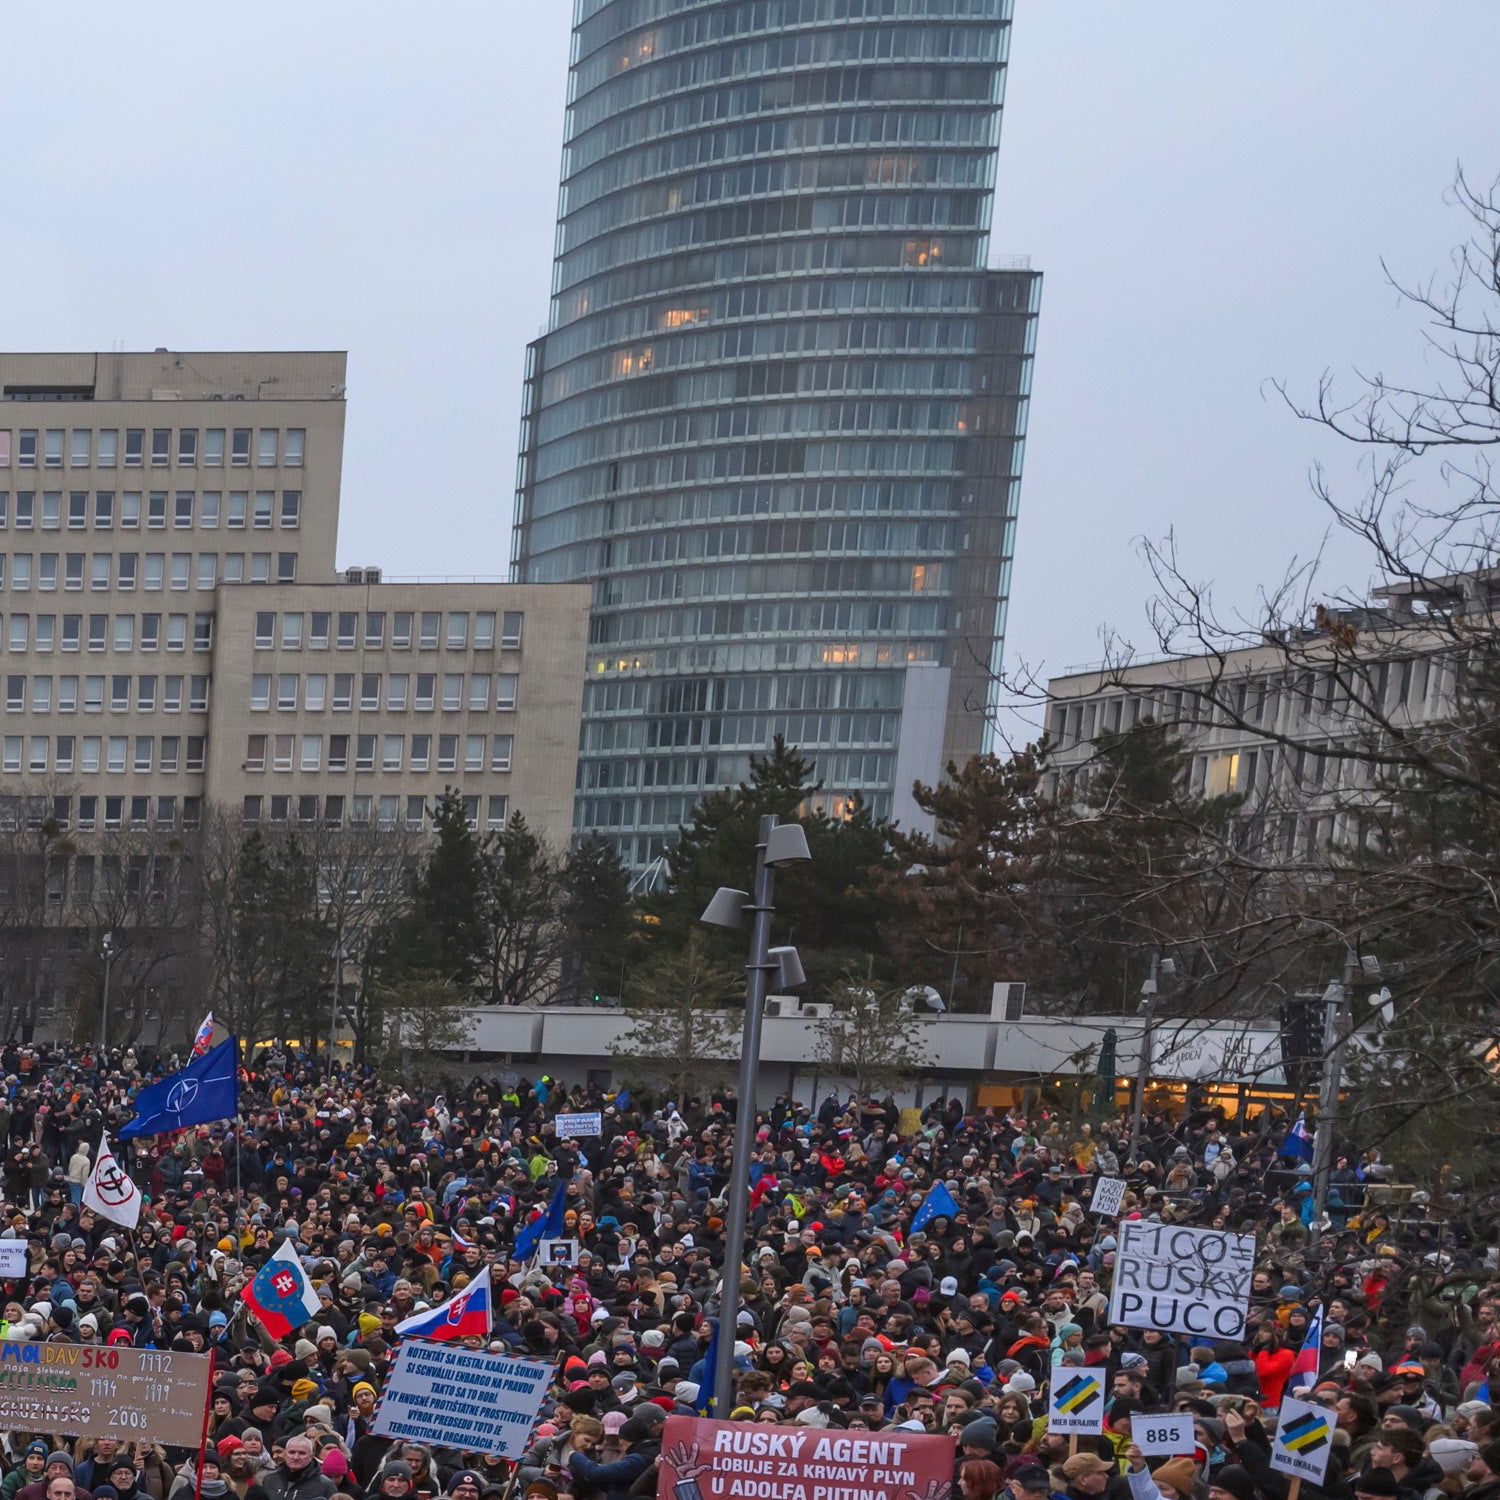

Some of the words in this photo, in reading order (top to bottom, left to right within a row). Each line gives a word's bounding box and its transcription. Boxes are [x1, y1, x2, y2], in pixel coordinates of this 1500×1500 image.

[1, 1343, 120, 1370] MOLDAVSKO
[138, 1353, 173, 1373] 1992
[145, 1384, 170, 1402] 1999
[502, 1378, 535, 1395] PRAVDU
[108, 1409, 147, 1429] 2008
[472, 1420, 493, 1435] TOTO
[1146, 1427, 1180, 1443] 885
[714, 1430, 804, 1459] RUSKÝ
[813, 1437, 908, 1466] AGENT
[712, 1457, 773, 1475] LOBUJE
[777, 1462, 798, 1477] ZA
[803, 1461, 868, 1483] KRVAVÝ
[873, 1470, 915, 1486] PLYN
[711, 1477, 725, 1495] U
